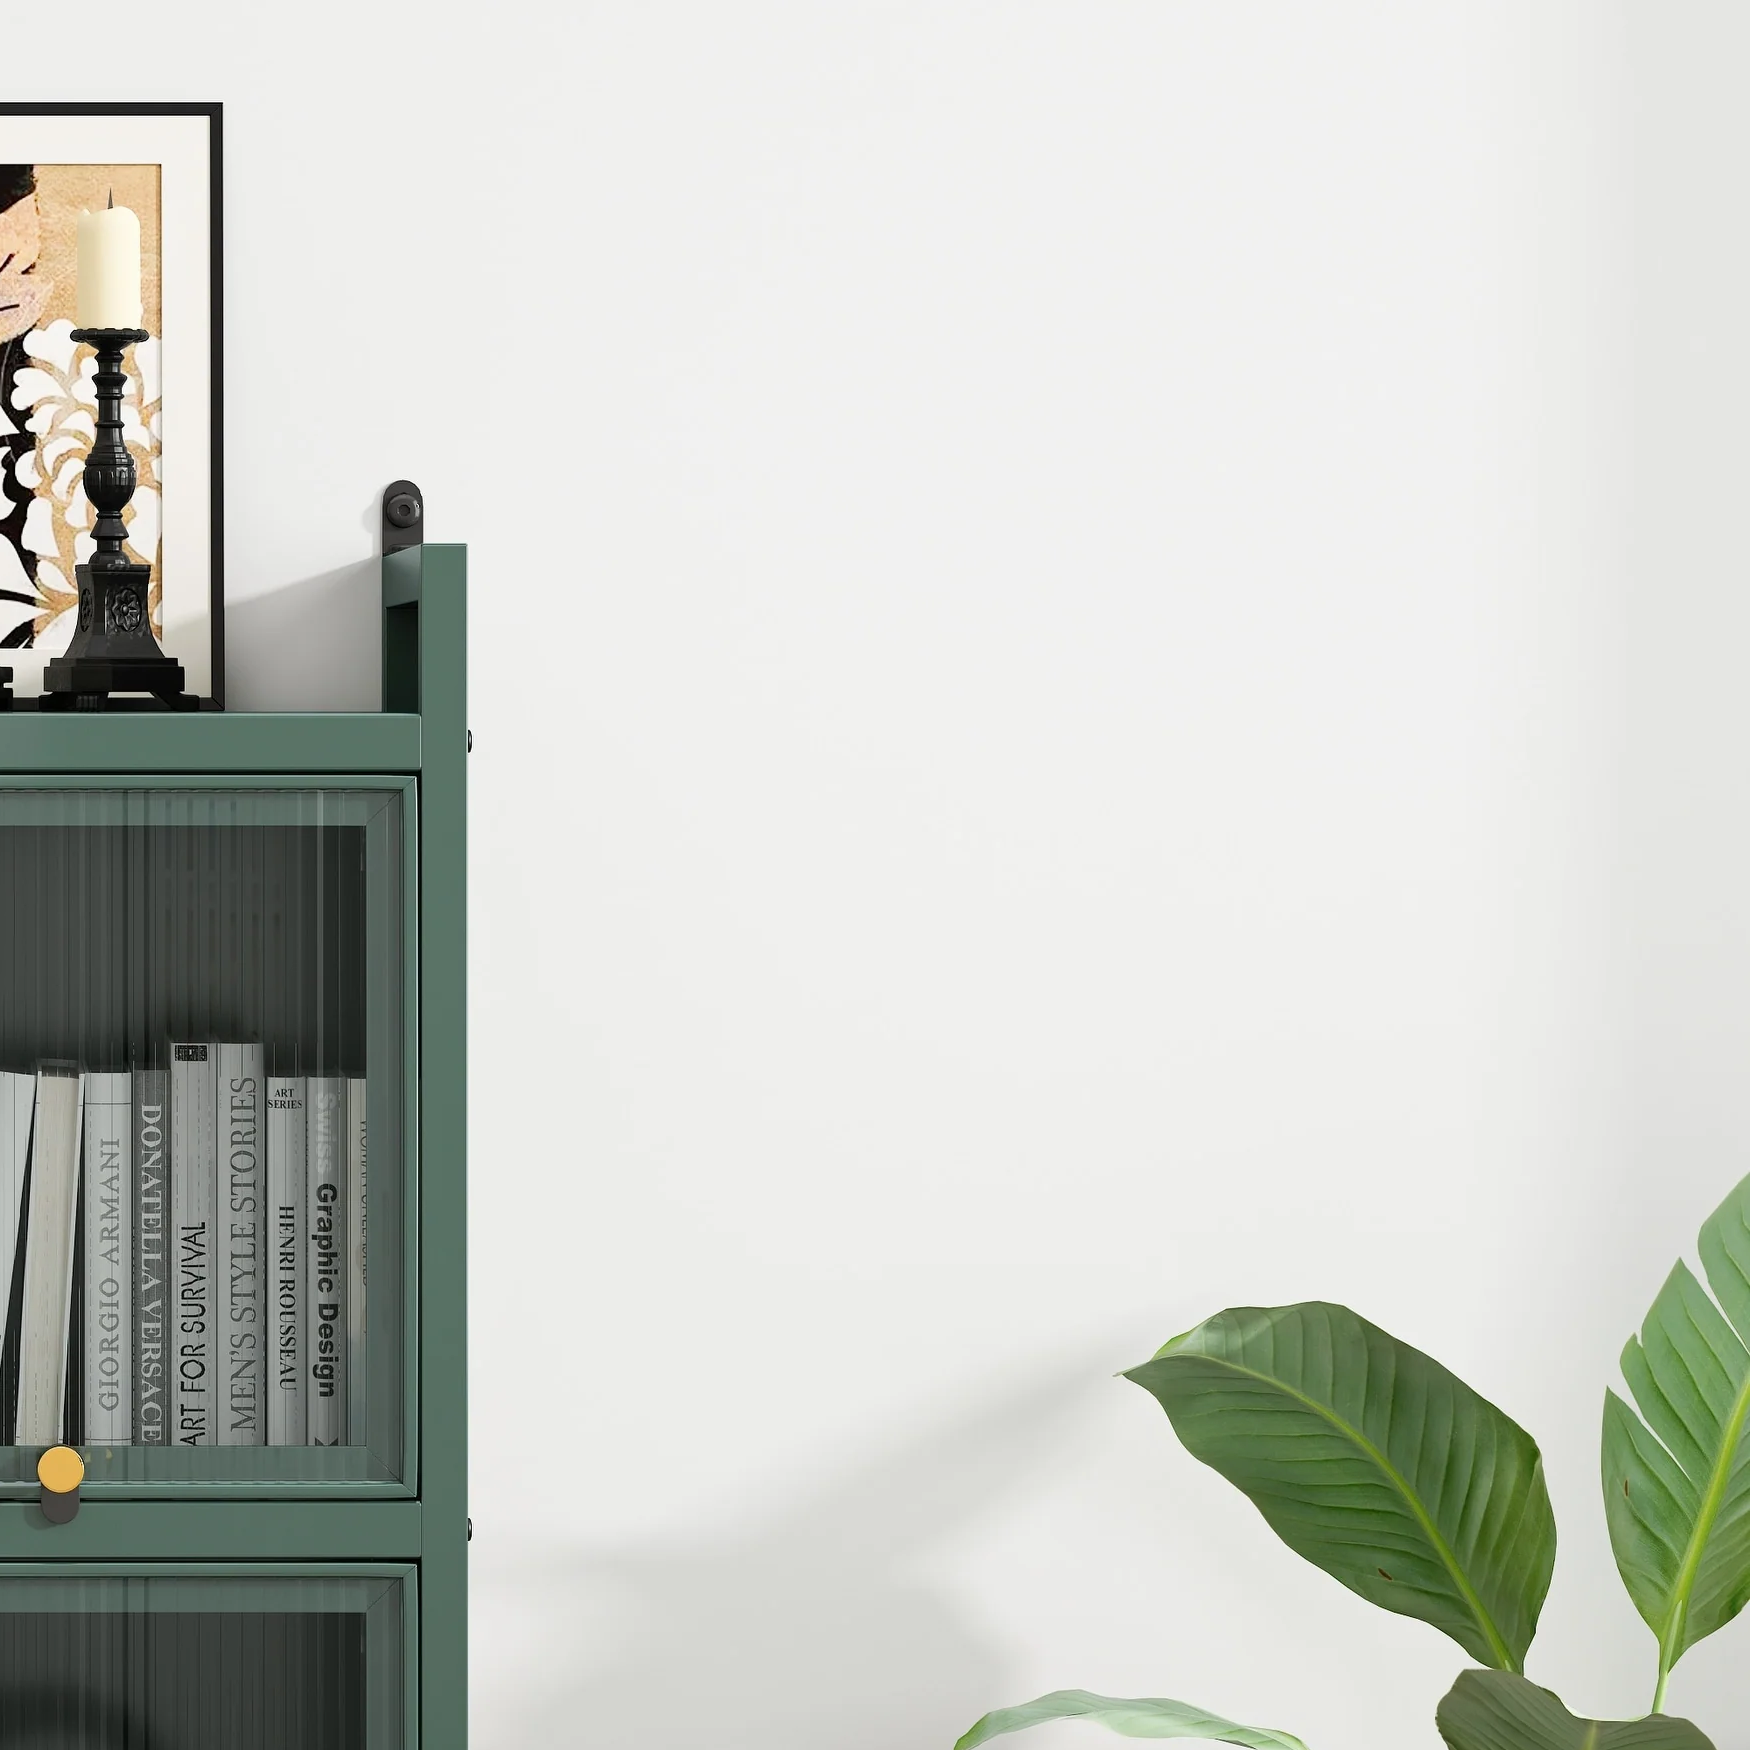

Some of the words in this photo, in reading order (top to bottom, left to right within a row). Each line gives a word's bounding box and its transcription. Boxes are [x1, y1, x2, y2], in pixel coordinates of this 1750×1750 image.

[230, 1077, 256, 1213] STORIES
[267, 1099, 303, 1109] SERIES
[274, 1088, 295, 1098] ART
[315, 1092, 338, 1175] Swiss
[99, 1138, 120, 1266] ARMANI
[141, 1103, 162, 1292] DONATELLA
[278, 1205, 296, 1272] HENRI
[311, 1183, 339, 1294] Graphic
[180, 1221, 207, 1334] SURVIVAL
[230, 1222, 256, 1323] STYLE
[98, 1277, 120, 1411] GIORGIO
[141, 1299, 162, 1442] VERSACE
[179, 1343, 206, 1393] FOR
[279, 1278, 297, 1391] ROUSSEAU
[312, 1303, 339, 1398] Design
[179, 1403, 206, 1446] ART
